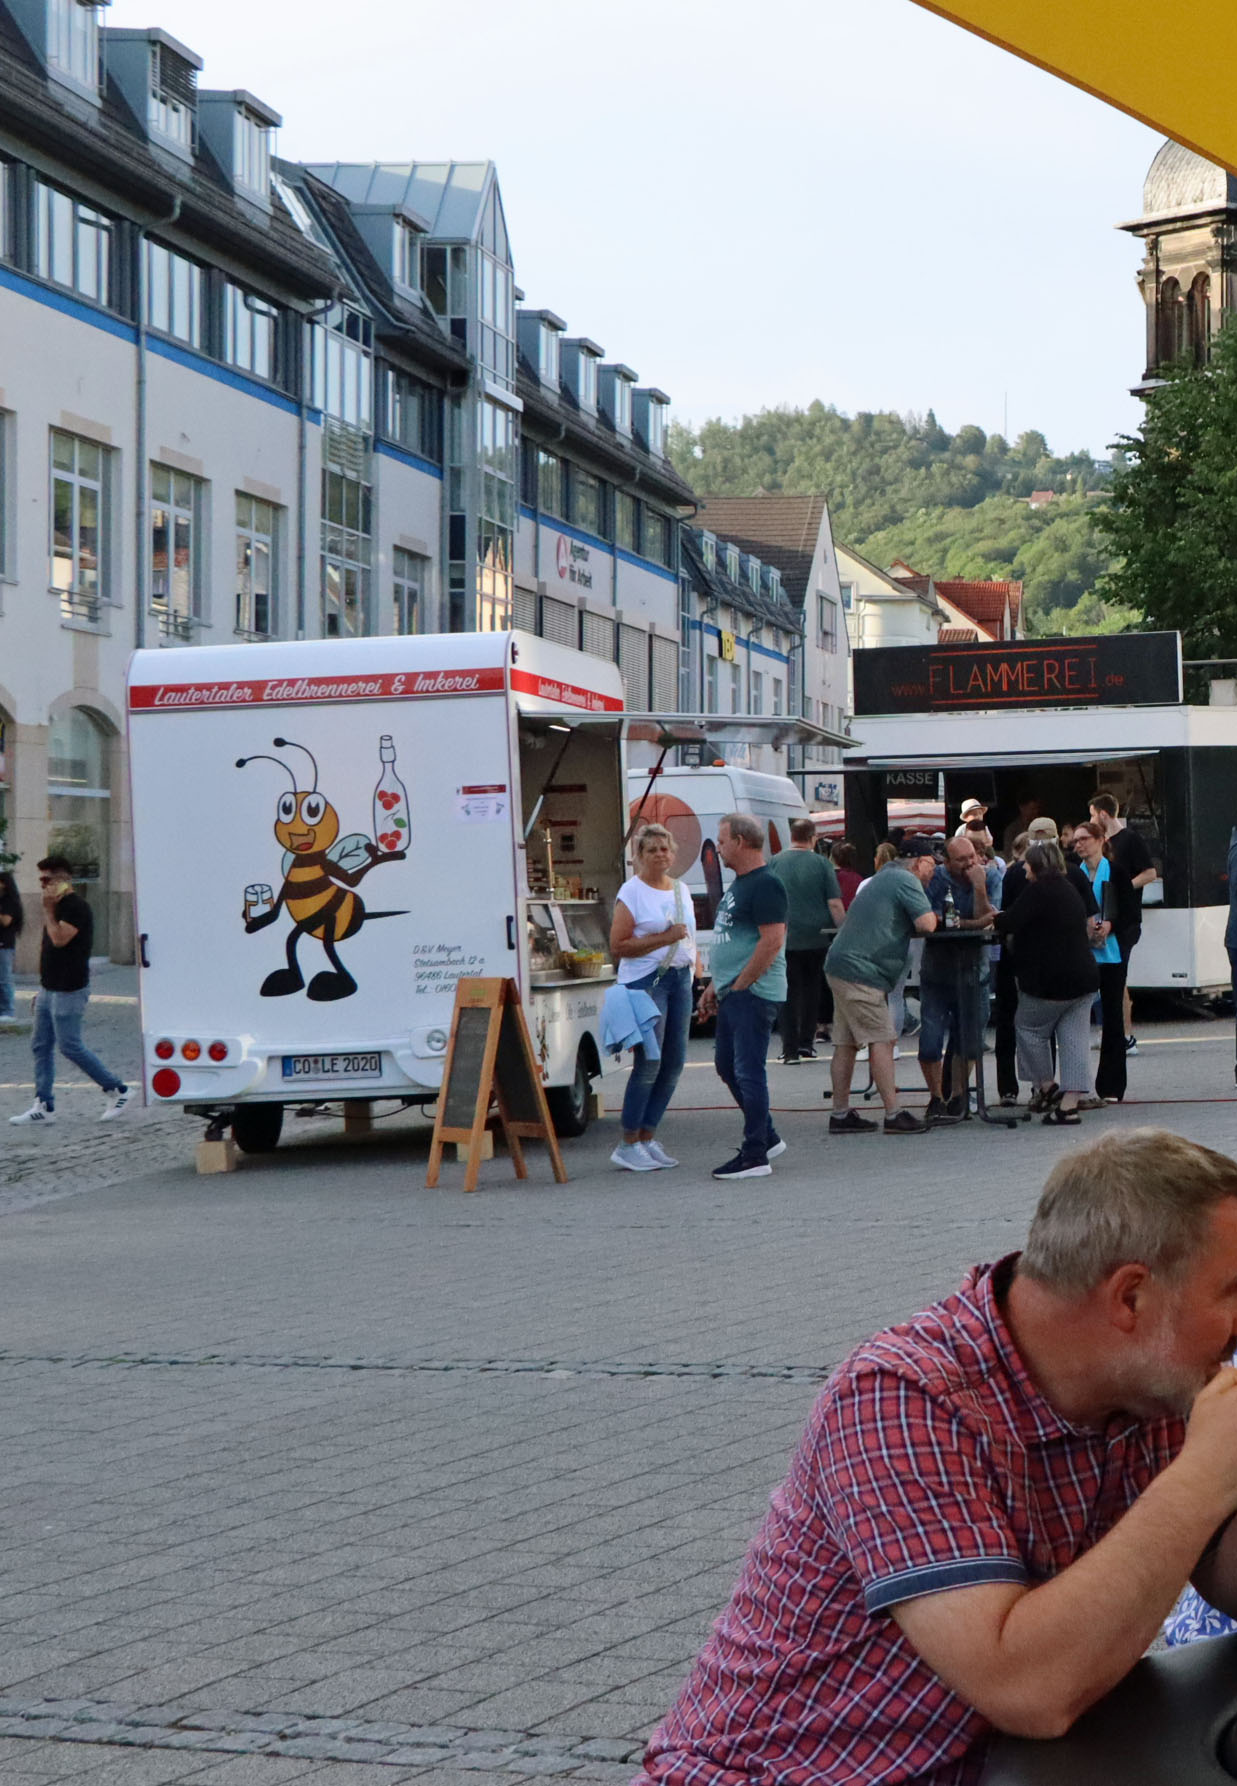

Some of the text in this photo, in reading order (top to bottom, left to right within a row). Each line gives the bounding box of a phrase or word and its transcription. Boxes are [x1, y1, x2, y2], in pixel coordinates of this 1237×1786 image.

[154, 672, 480, 706] Lautertaler Edelbrennerei & Imkerei
[886, 771, 934, 785] KASSE
[293, 1055, 378, 1074] CO LE 2020
